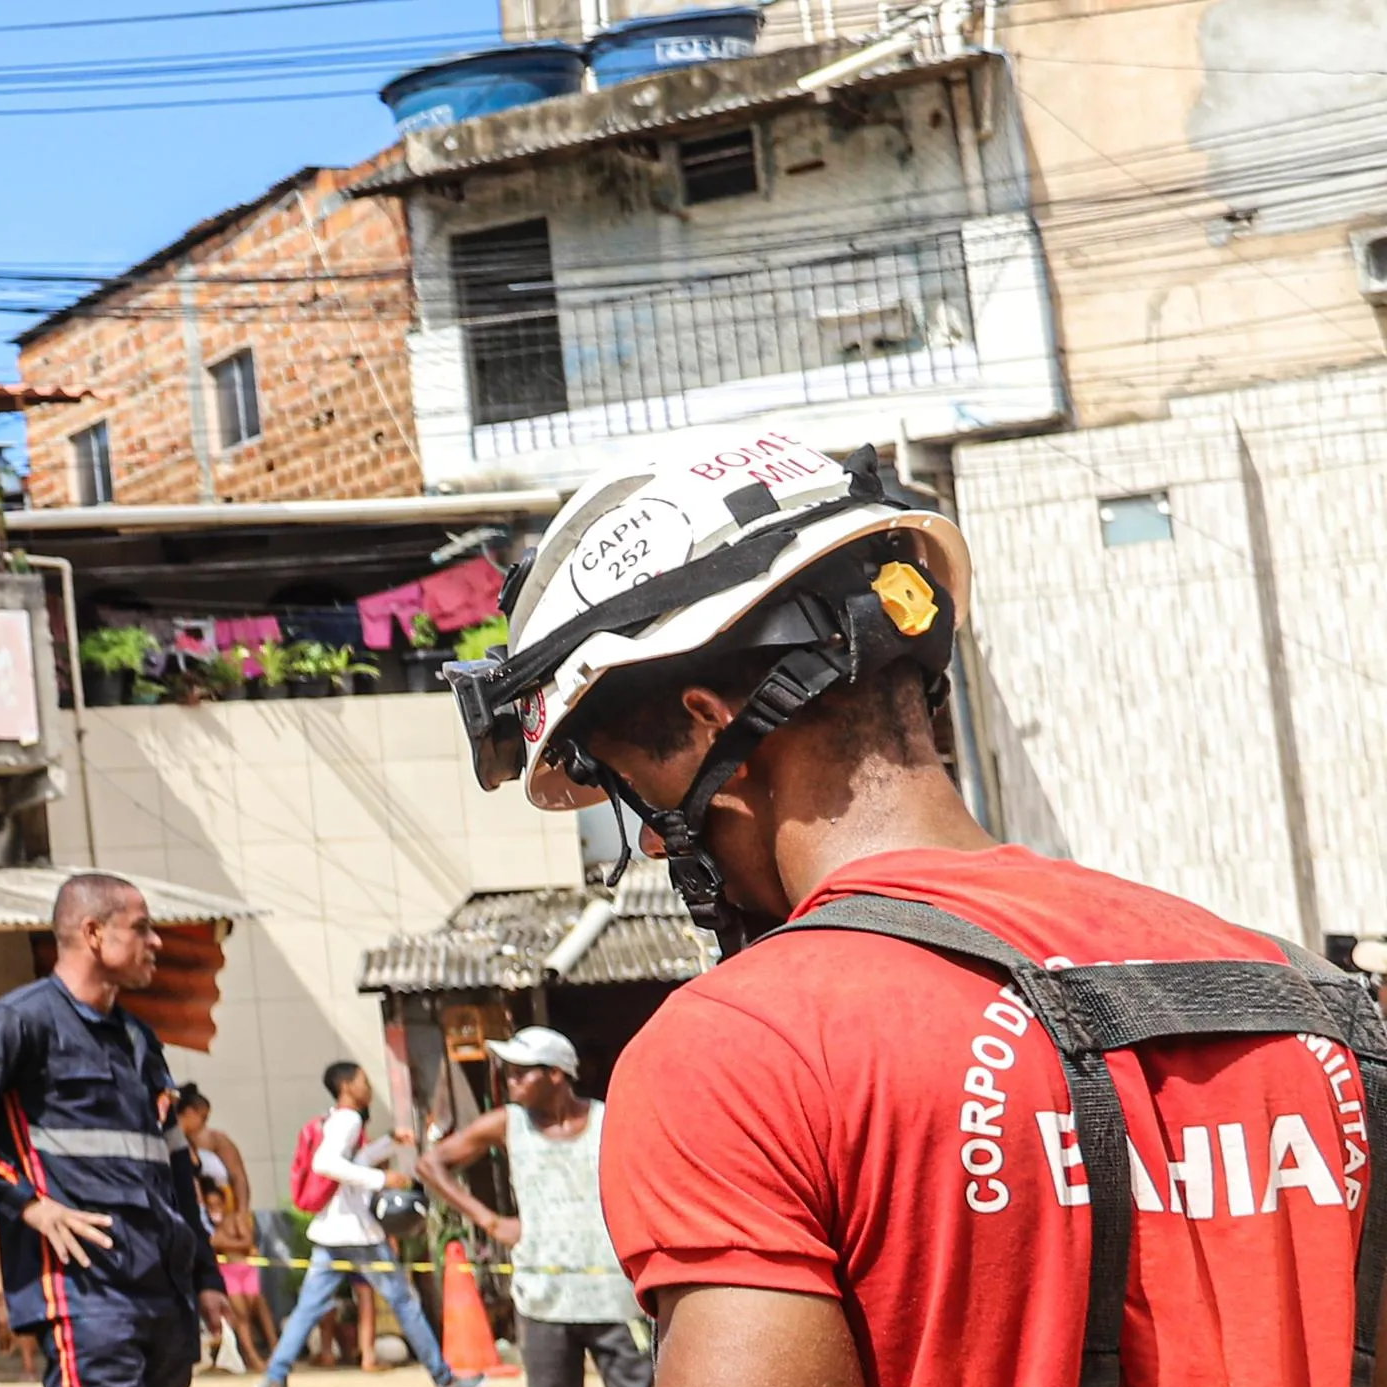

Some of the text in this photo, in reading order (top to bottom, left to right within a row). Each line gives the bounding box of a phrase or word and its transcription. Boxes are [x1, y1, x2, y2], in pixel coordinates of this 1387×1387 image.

[581, 509, 652, 571] CAPH
[608, 539, 651, 581] 252
[960, 1034, 1016, 1214] CORPO
